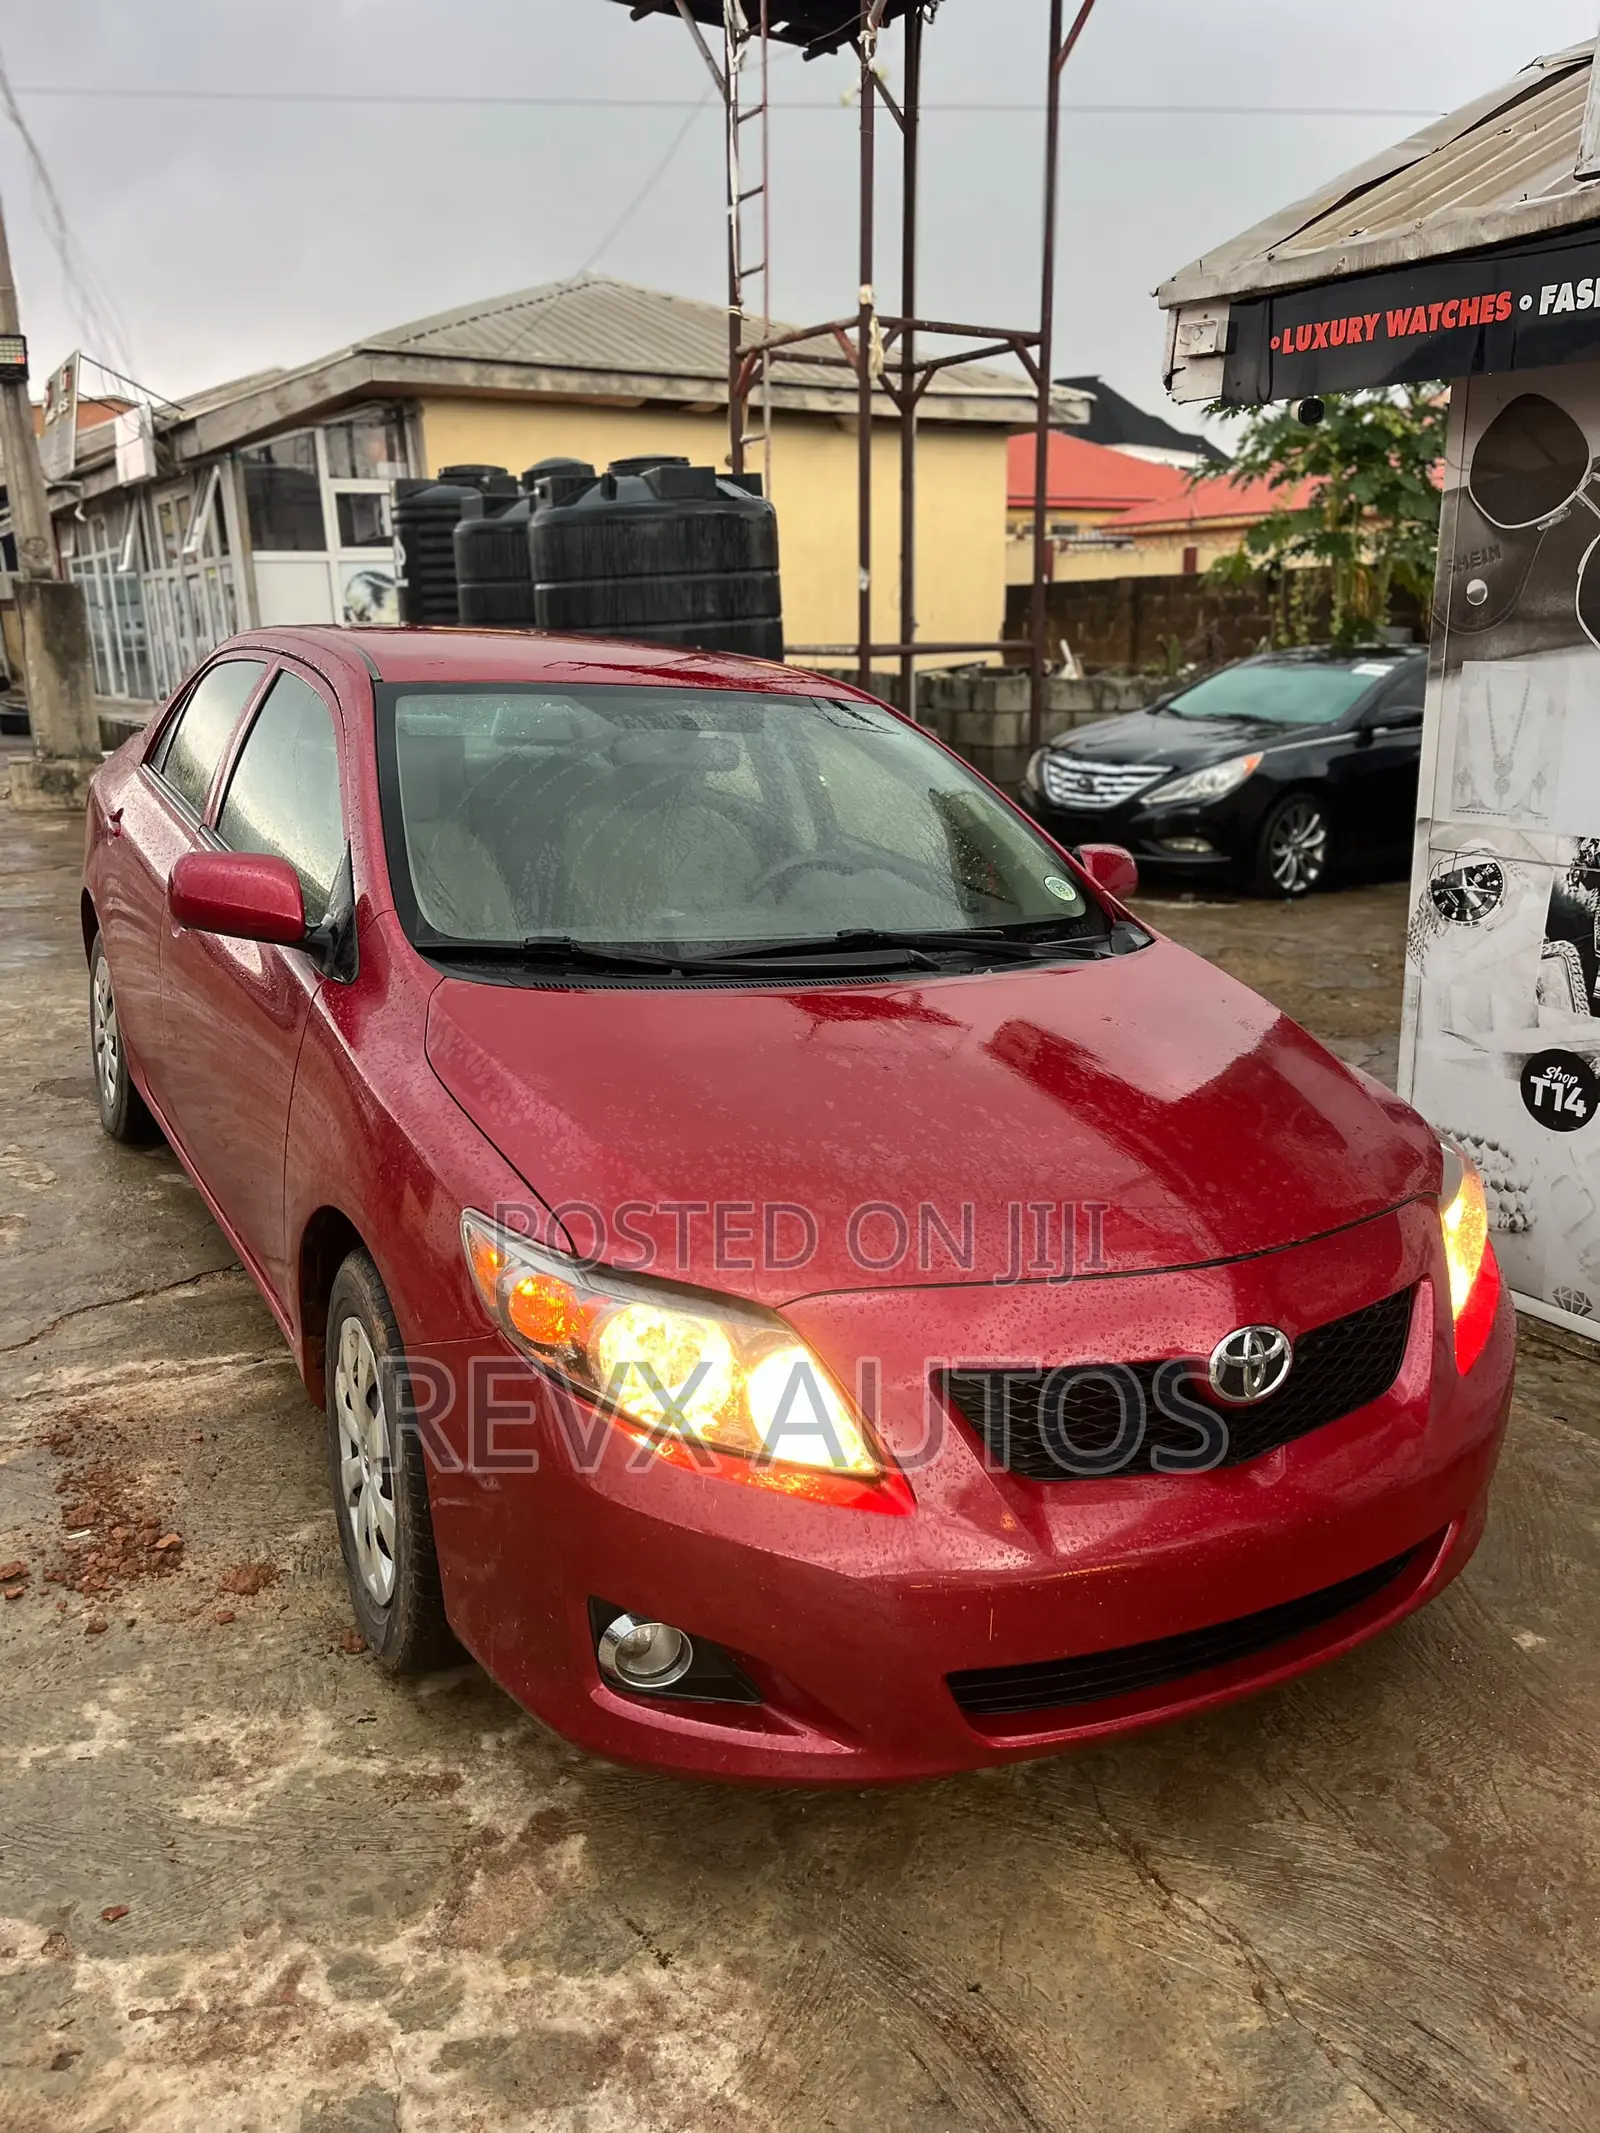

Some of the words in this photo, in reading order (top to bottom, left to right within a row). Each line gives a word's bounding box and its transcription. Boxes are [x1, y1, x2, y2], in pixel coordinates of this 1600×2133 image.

[1282, 312, 1381, 355] LUXURY
[1386, 291, 1513, 338] WATCHES
[1530, 1075, 1587, 1118] T14
[1542, 1066, 1579, 1089] Shop
